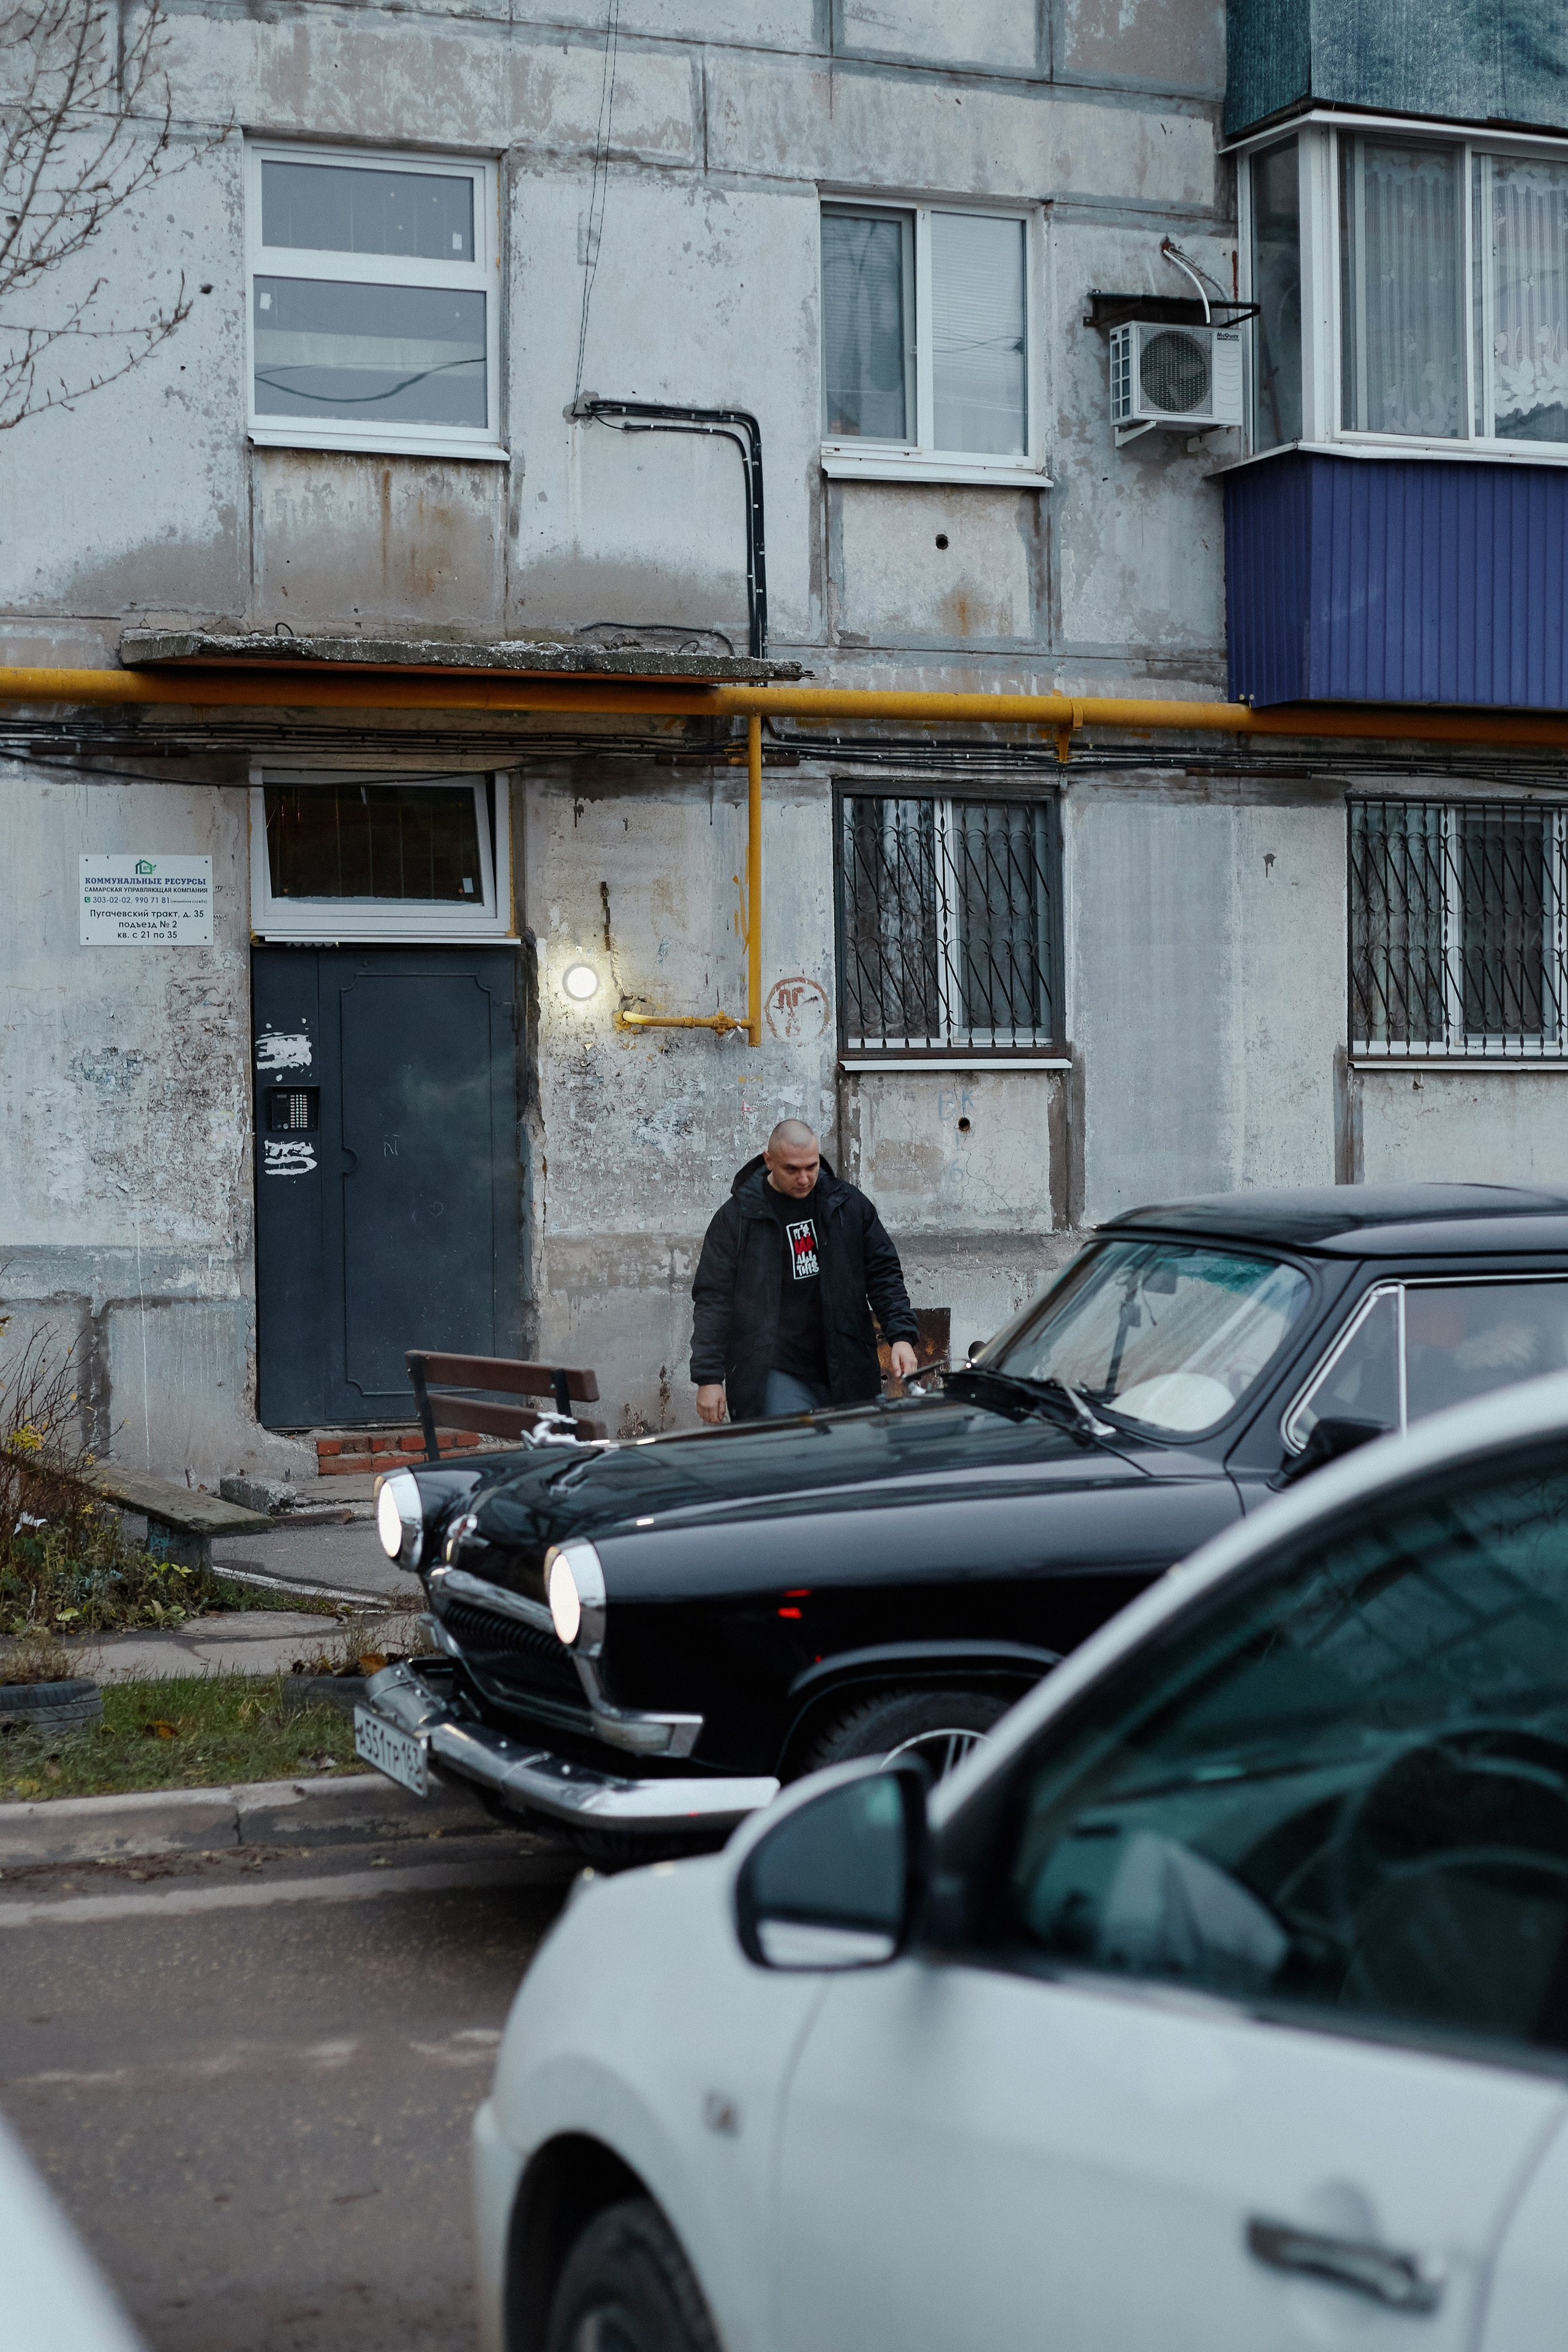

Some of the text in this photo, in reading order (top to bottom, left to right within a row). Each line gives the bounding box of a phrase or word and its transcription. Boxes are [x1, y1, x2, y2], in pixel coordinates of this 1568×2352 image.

[90, 909, 149, 919] Пугачевский
[194, 910, 204, 918] 35
[796, 1254, 820, 1276] THIS
